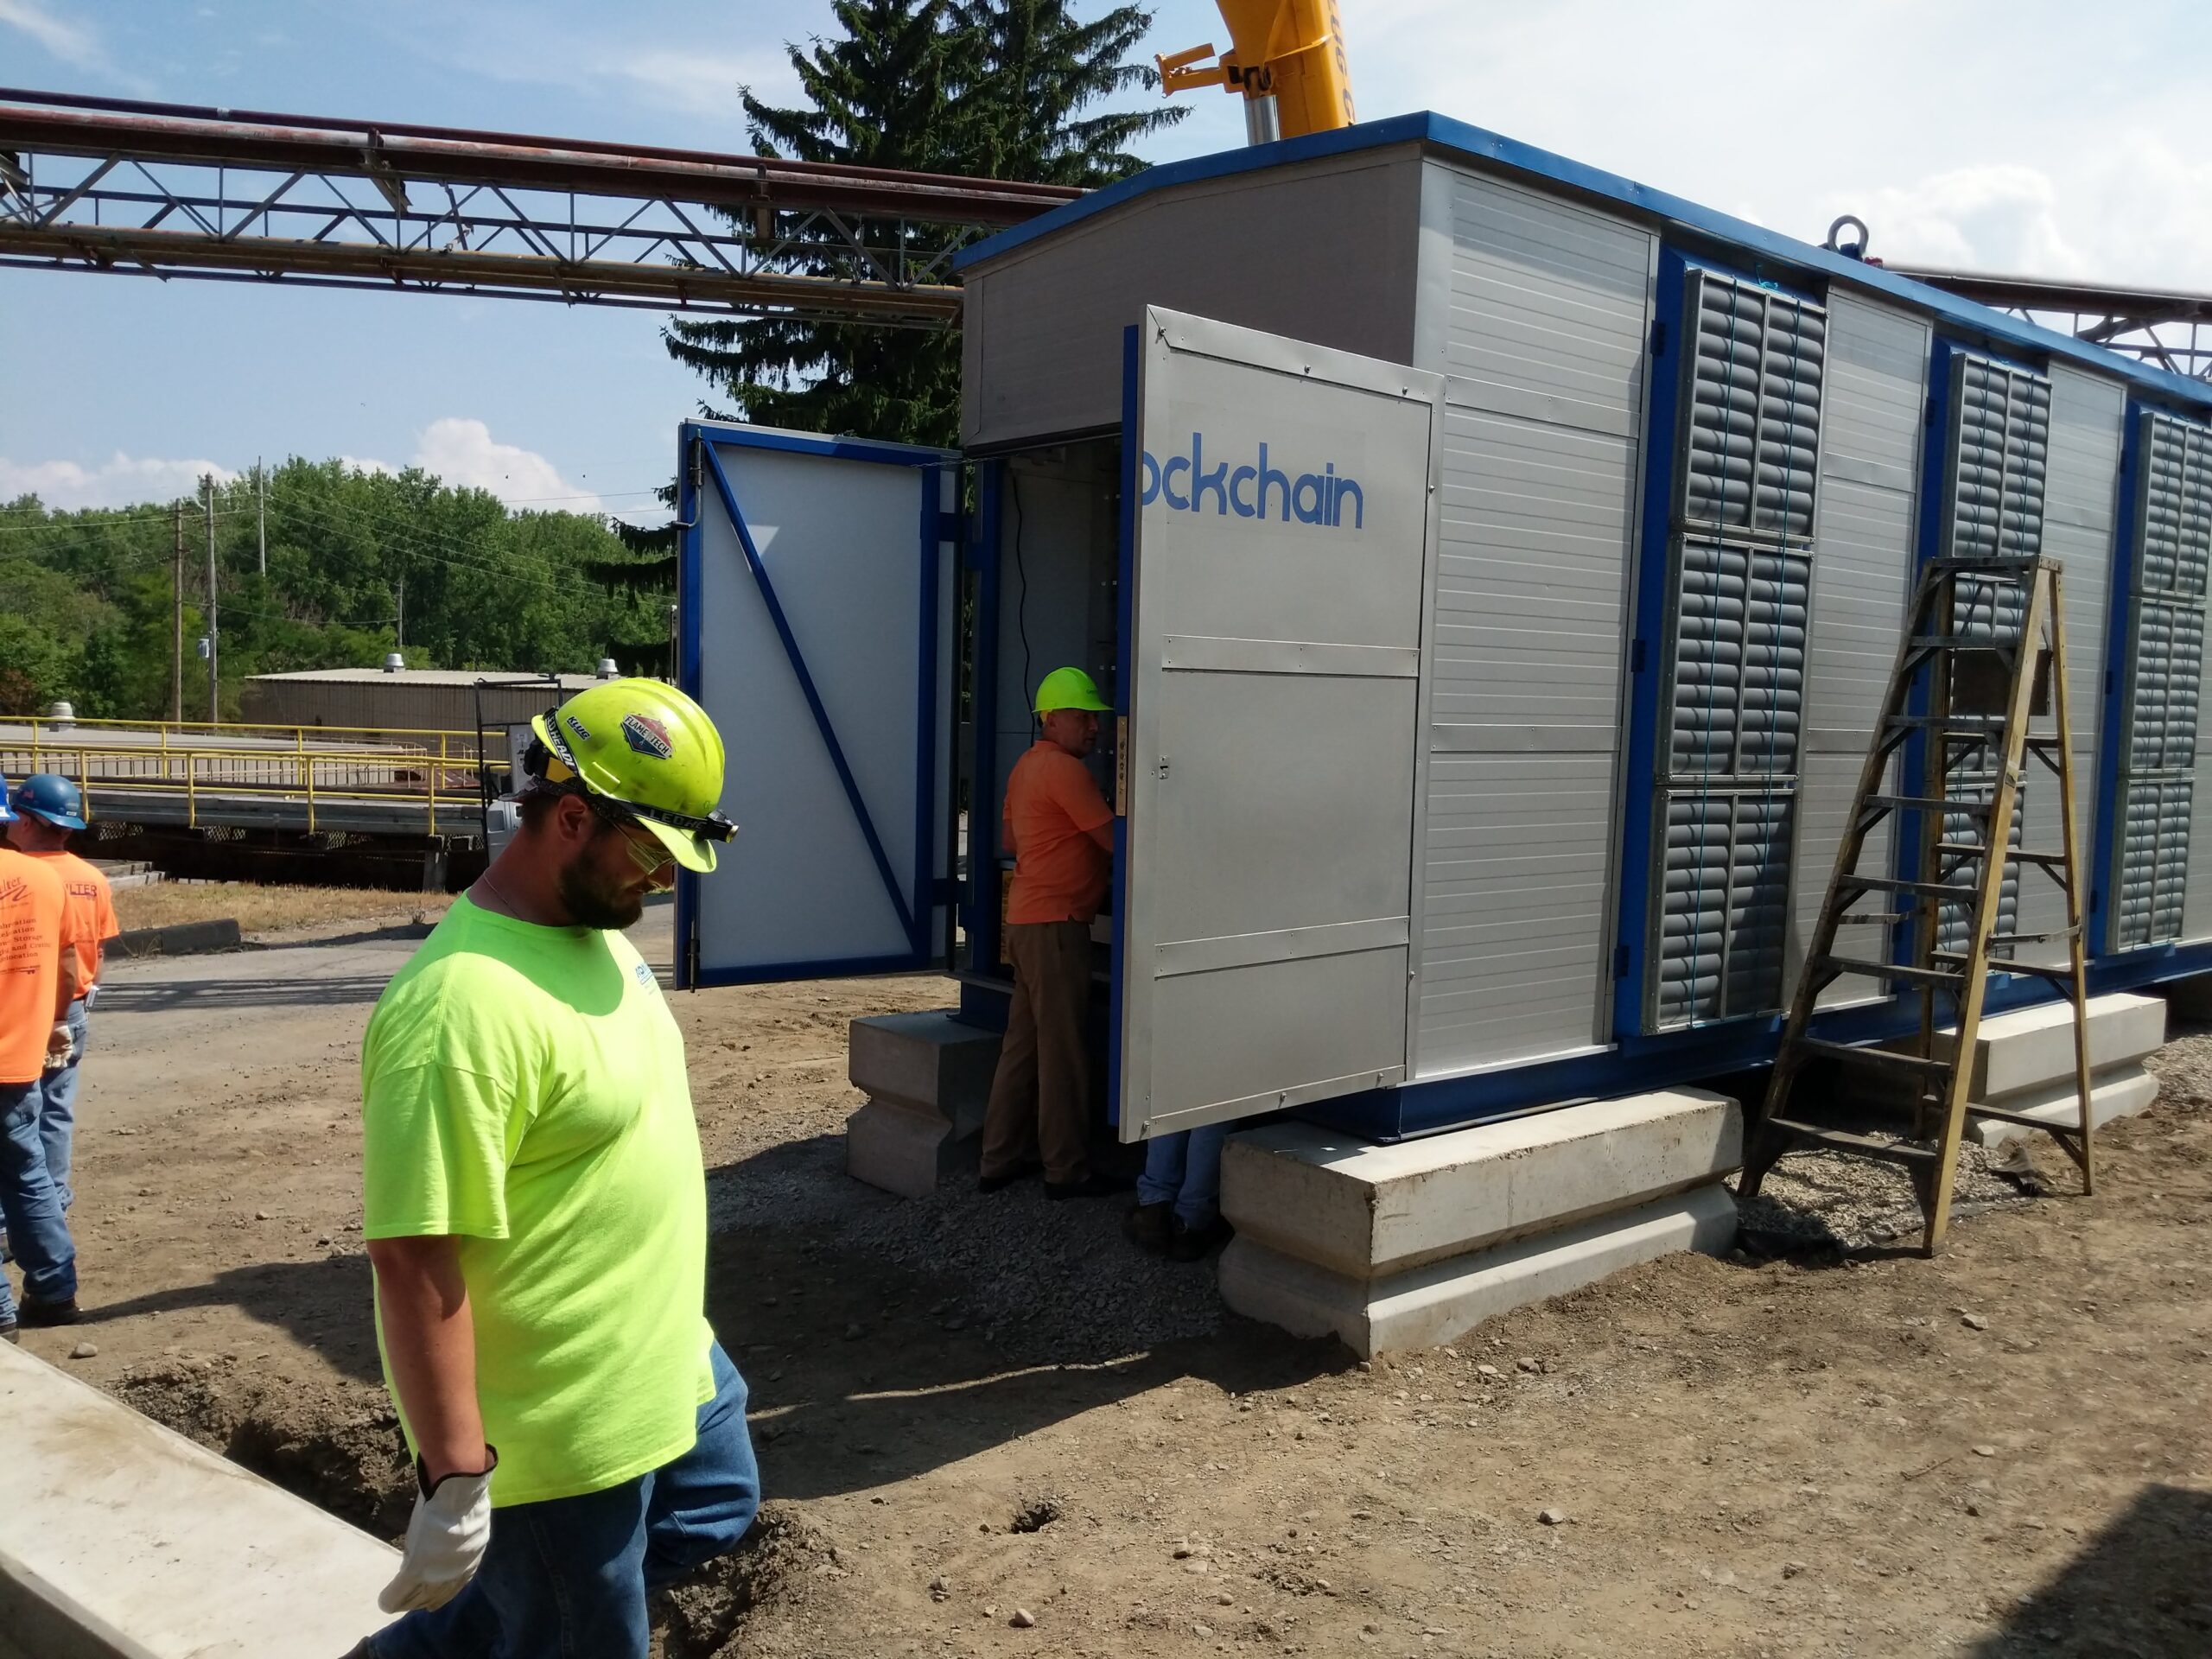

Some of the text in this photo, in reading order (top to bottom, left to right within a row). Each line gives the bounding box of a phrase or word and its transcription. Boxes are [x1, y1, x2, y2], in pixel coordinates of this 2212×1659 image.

[568, 715, 590, 739] KLUG
[625, 715, 649, 736] FLAME
[650, 735, 670, 754] TECH
[66, 883, 97, 896] LTER
